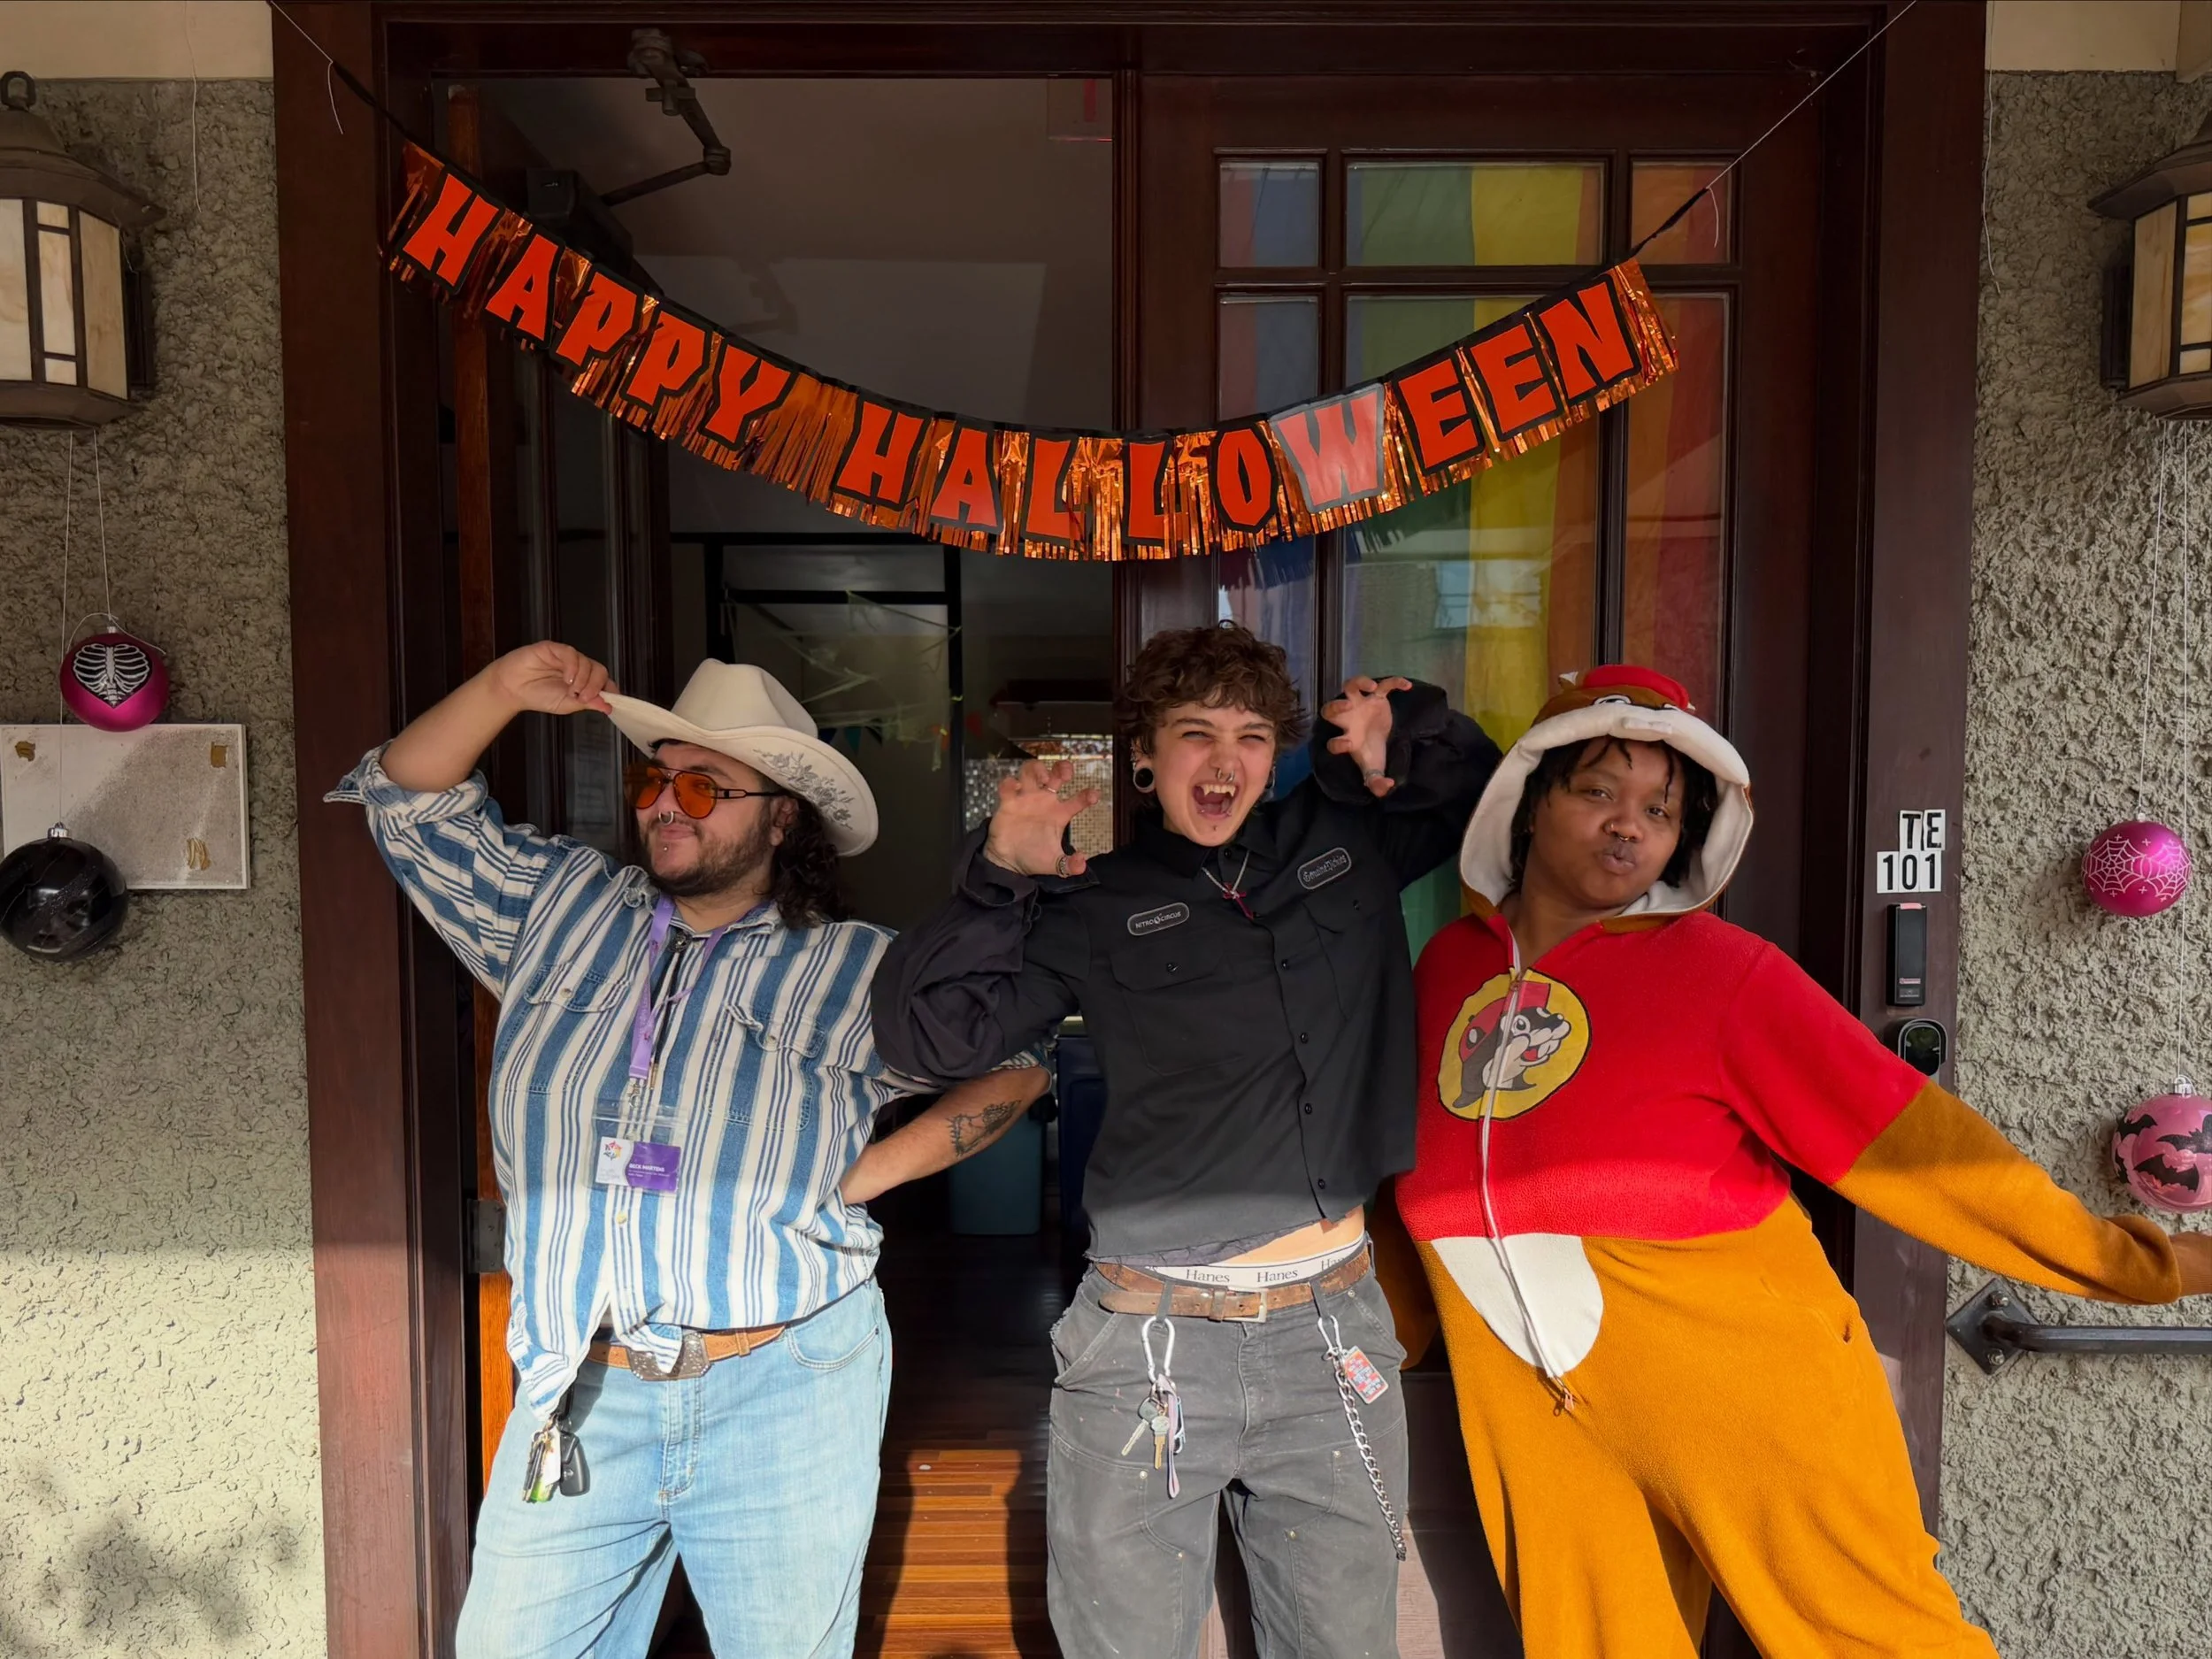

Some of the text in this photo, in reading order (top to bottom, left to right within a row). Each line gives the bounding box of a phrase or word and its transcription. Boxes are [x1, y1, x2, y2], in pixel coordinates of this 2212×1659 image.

[402, 173, 1634, 539] HAPPY HALLOWEEN
[1901, 812, 1942, 849] TE
[1882, 853, 1937, 890] 101
[1135, 911, 1182, 929] NITRO CIRCUS
[1186, 1268, 1299, 1283] Hanes Hanes
